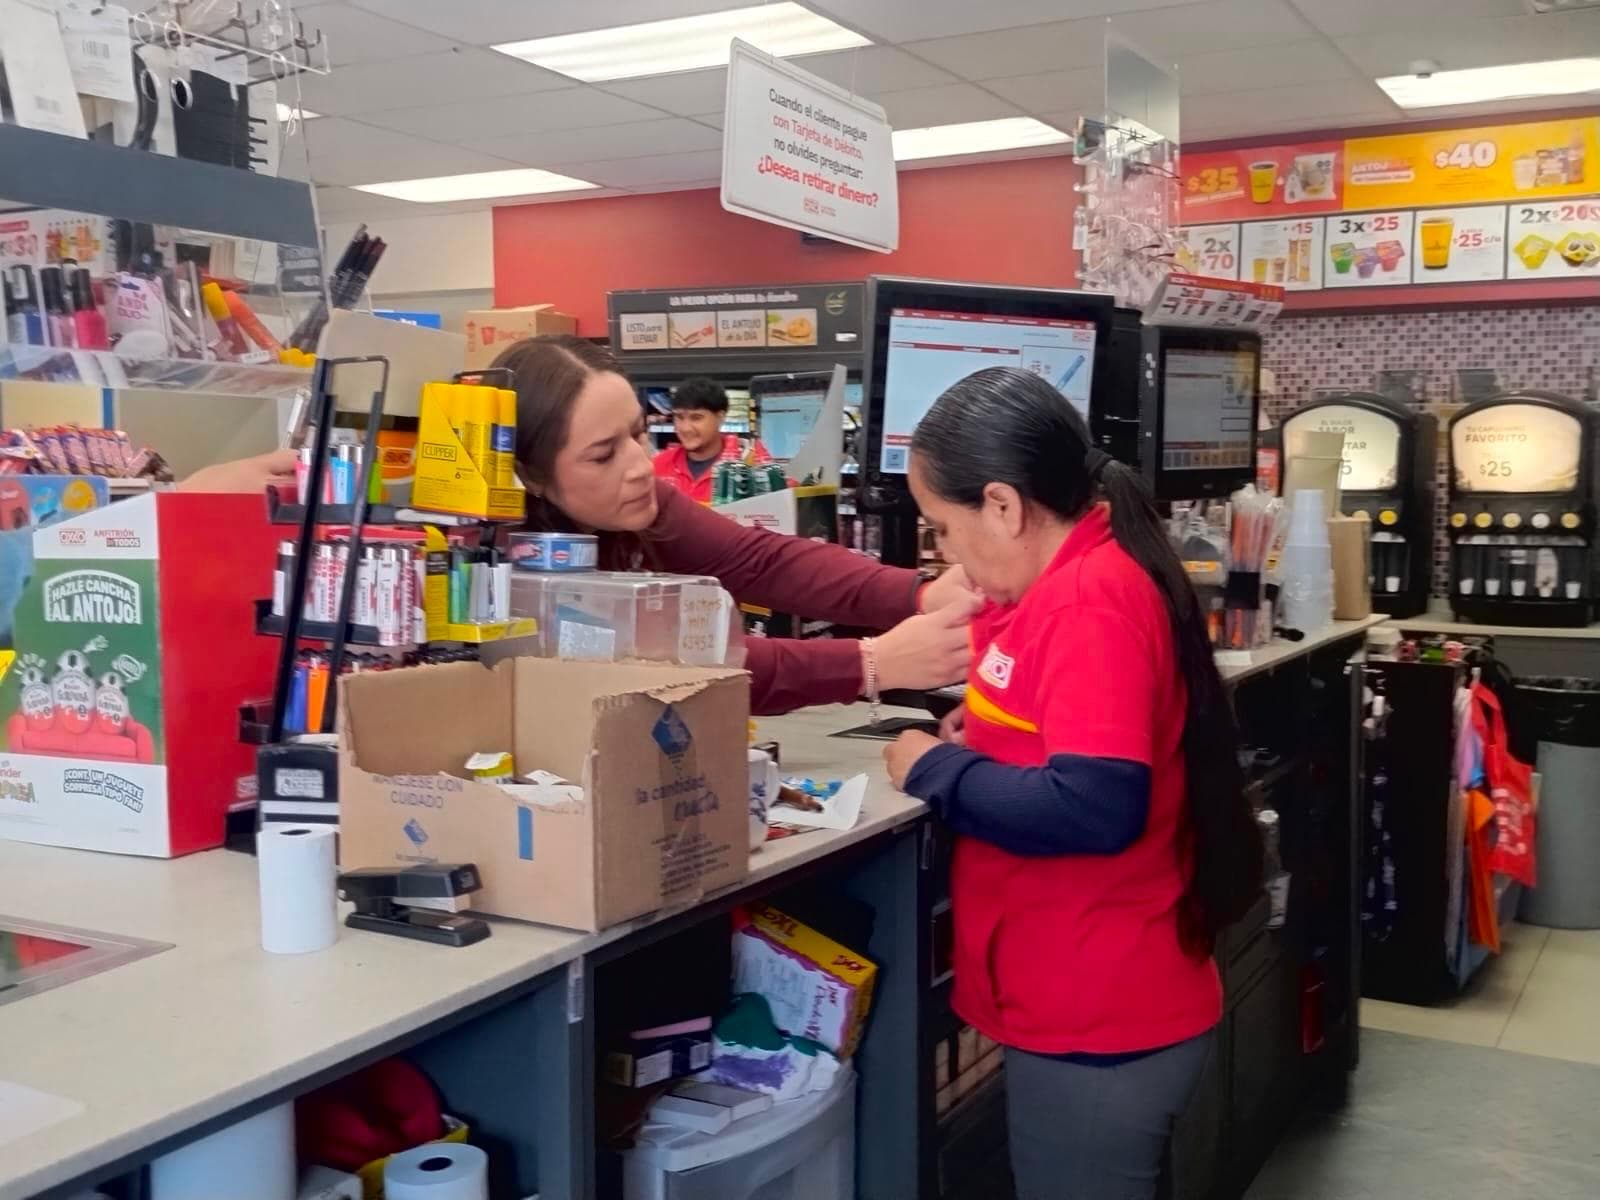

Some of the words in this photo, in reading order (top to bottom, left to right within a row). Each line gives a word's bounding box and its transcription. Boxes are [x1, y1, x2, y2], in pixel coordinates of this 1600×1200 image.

[769, 87, 803, 114] Cuando
[804, 104, 812, 118] el
[814, 109, 840, 131] cliente
[842, 124, 867, 141] pague
[773, 114, 789, 130] con
[792, 118, 820, 142] Tarjeta
[822, 133, 832, 148] de
[774, 137, 785, 151] no
[787, 141, 818, 163] olvides
[1434, 141, 1497, 169] $40
[758, 155, 800, 182] ¿Desea
[802, 171, 835, 194] retirar
[838, 181, 879, 208] dinero?
[1187, 166, 1238, 194] $35
[1340, 219, 1366, 234] 3x
[1520, 207, 1551, 224] 2x
[1204, 237, 1231, 254] 2x
[1464, 433, 1528, 444] FAVORITO
[424, 445, 454, 459] CLIPPER
[1479, 460, 1513, 477] $25
[52, 580, 85, 601] HAZLE
[85, 579, 132, 604] CANCHA
[52, 599, 71, 622] AL
[73, 593, 135, 624] ANTOJO
